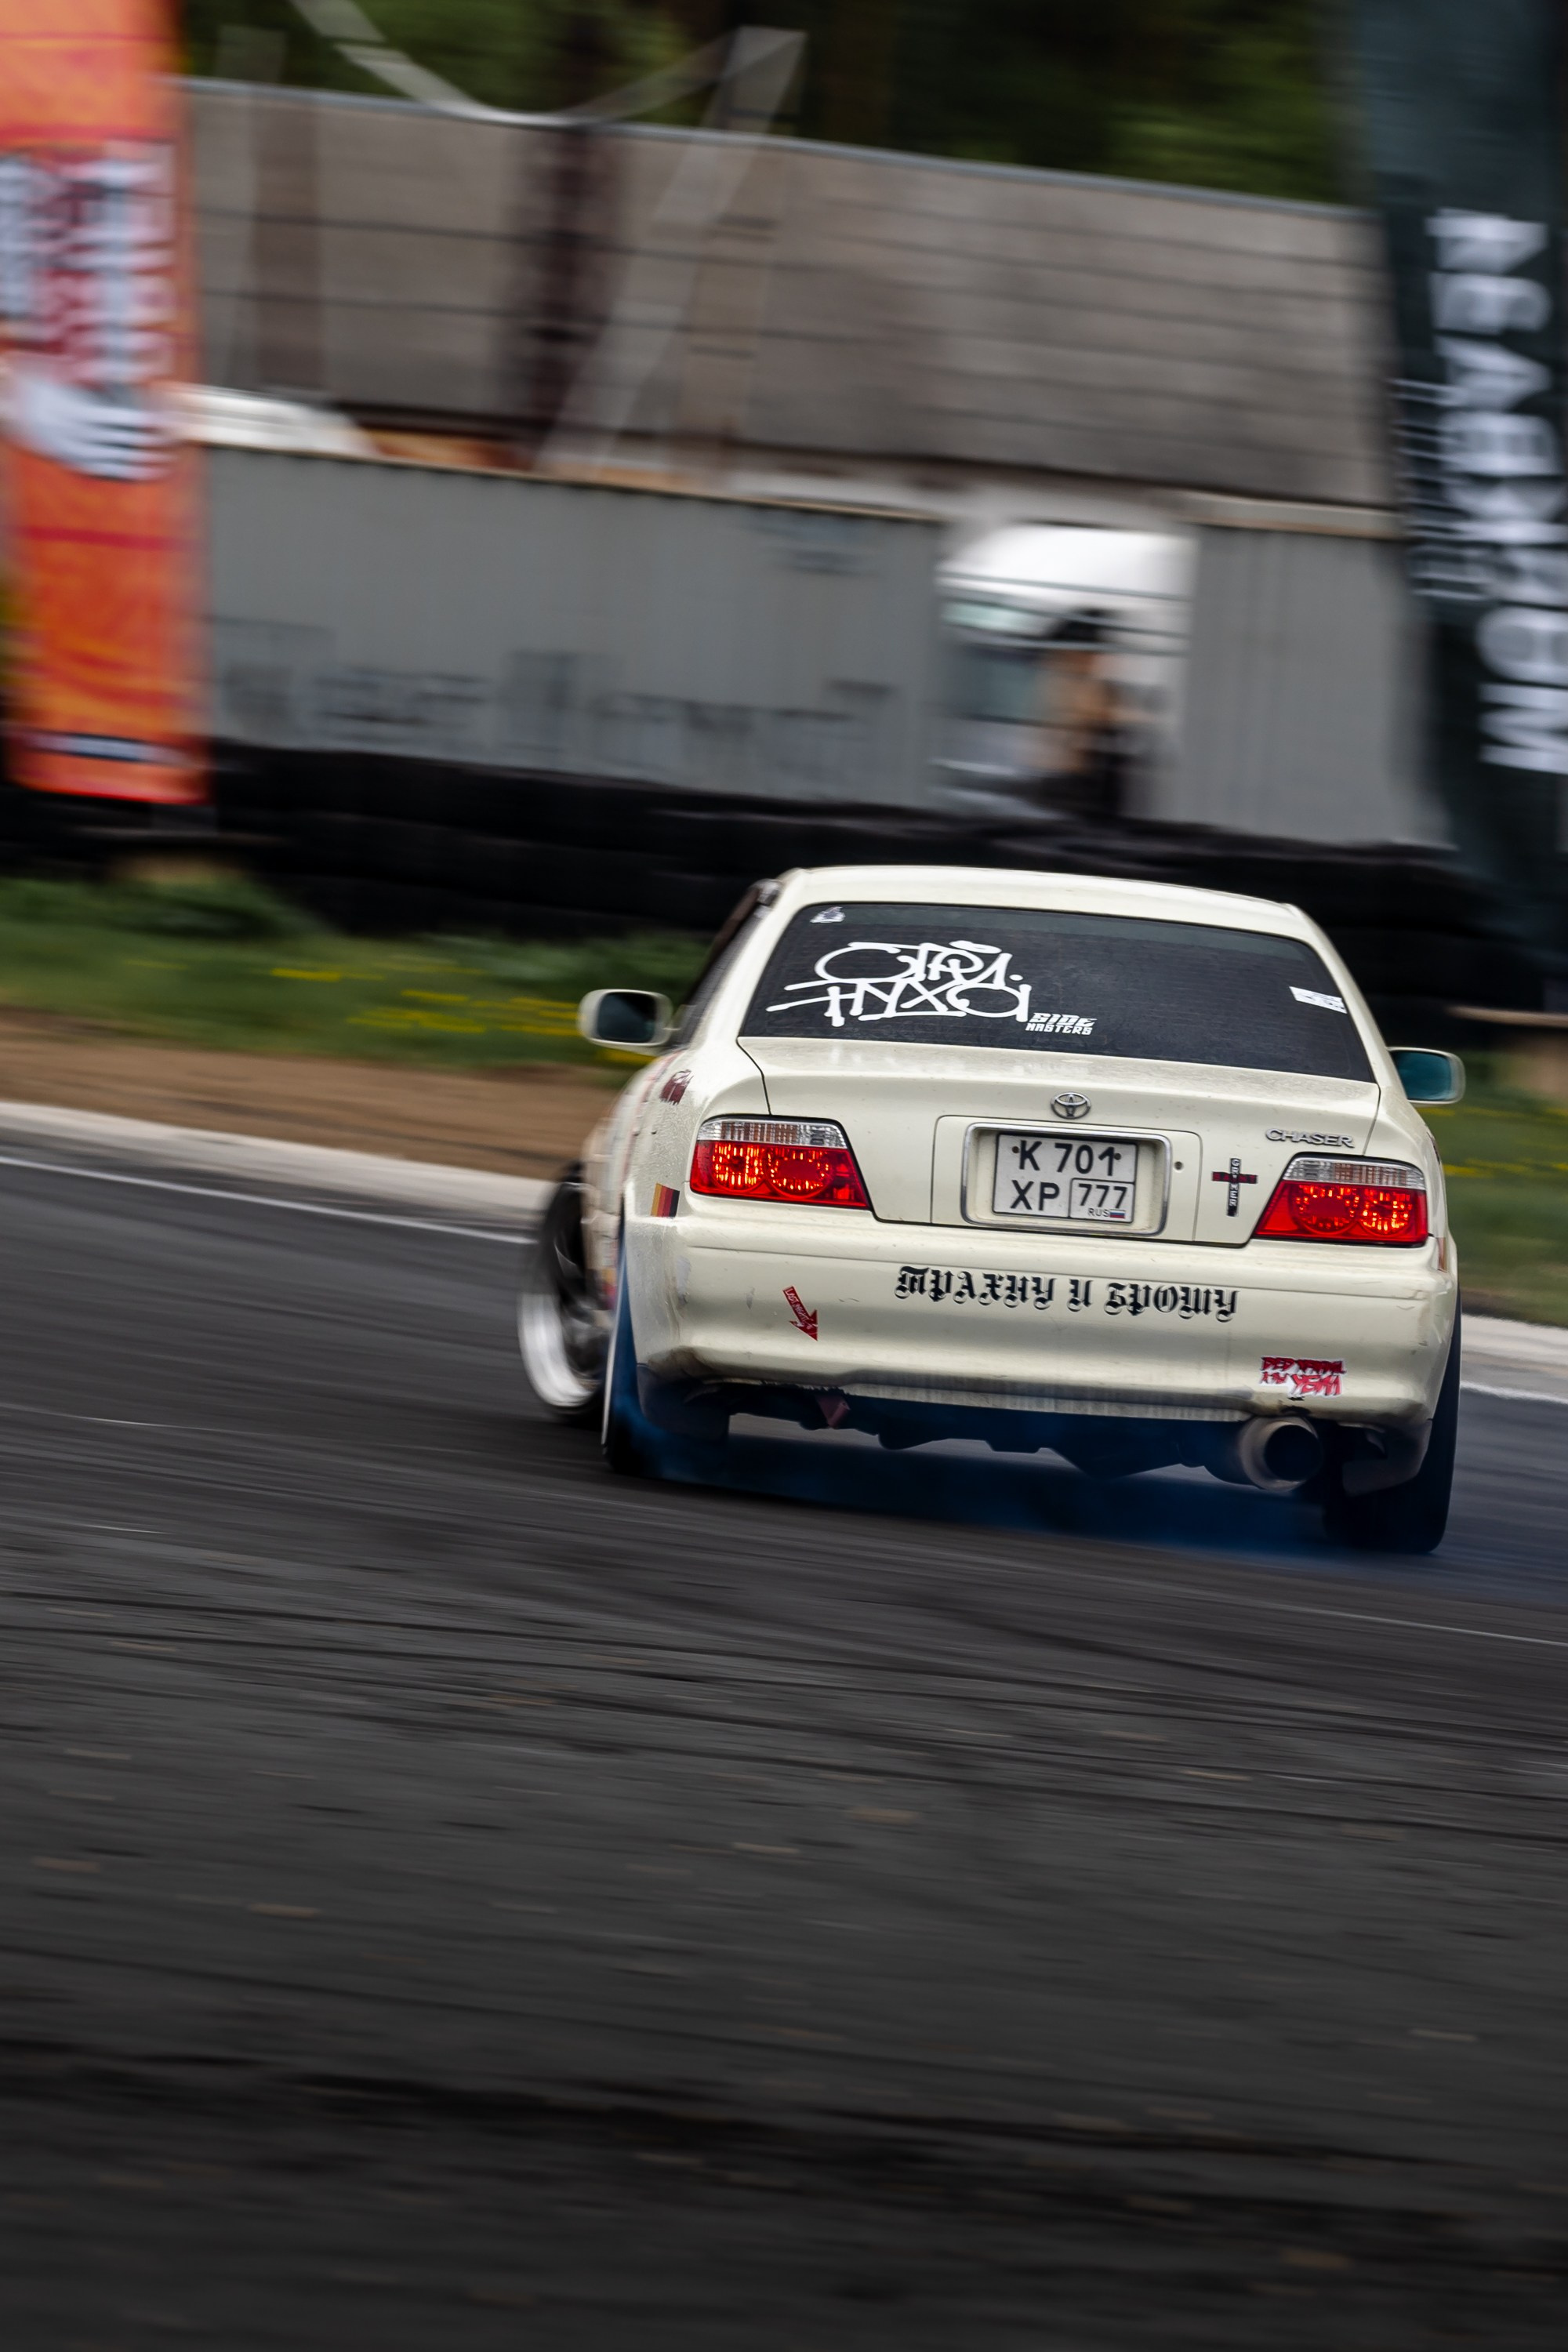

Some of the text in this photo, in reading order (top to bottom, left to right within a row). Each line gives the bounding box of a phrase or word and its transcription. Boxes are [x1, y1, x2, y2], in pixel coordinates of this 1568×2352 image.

[1021, 1022, 1093, 1035] MASTERS
[1029, 1012, 1097, 1027] SIDE
[1265, 1129, 1355, 1149] CHASER
[1054, 1142, 1115, 1176] 701
[1079, 1183, 1127, 1209] 777
[1087, 1208, 1110, 1218] RUS
[894, 1265, 1240, 1323] ТРАХНУ И БРОШУ
